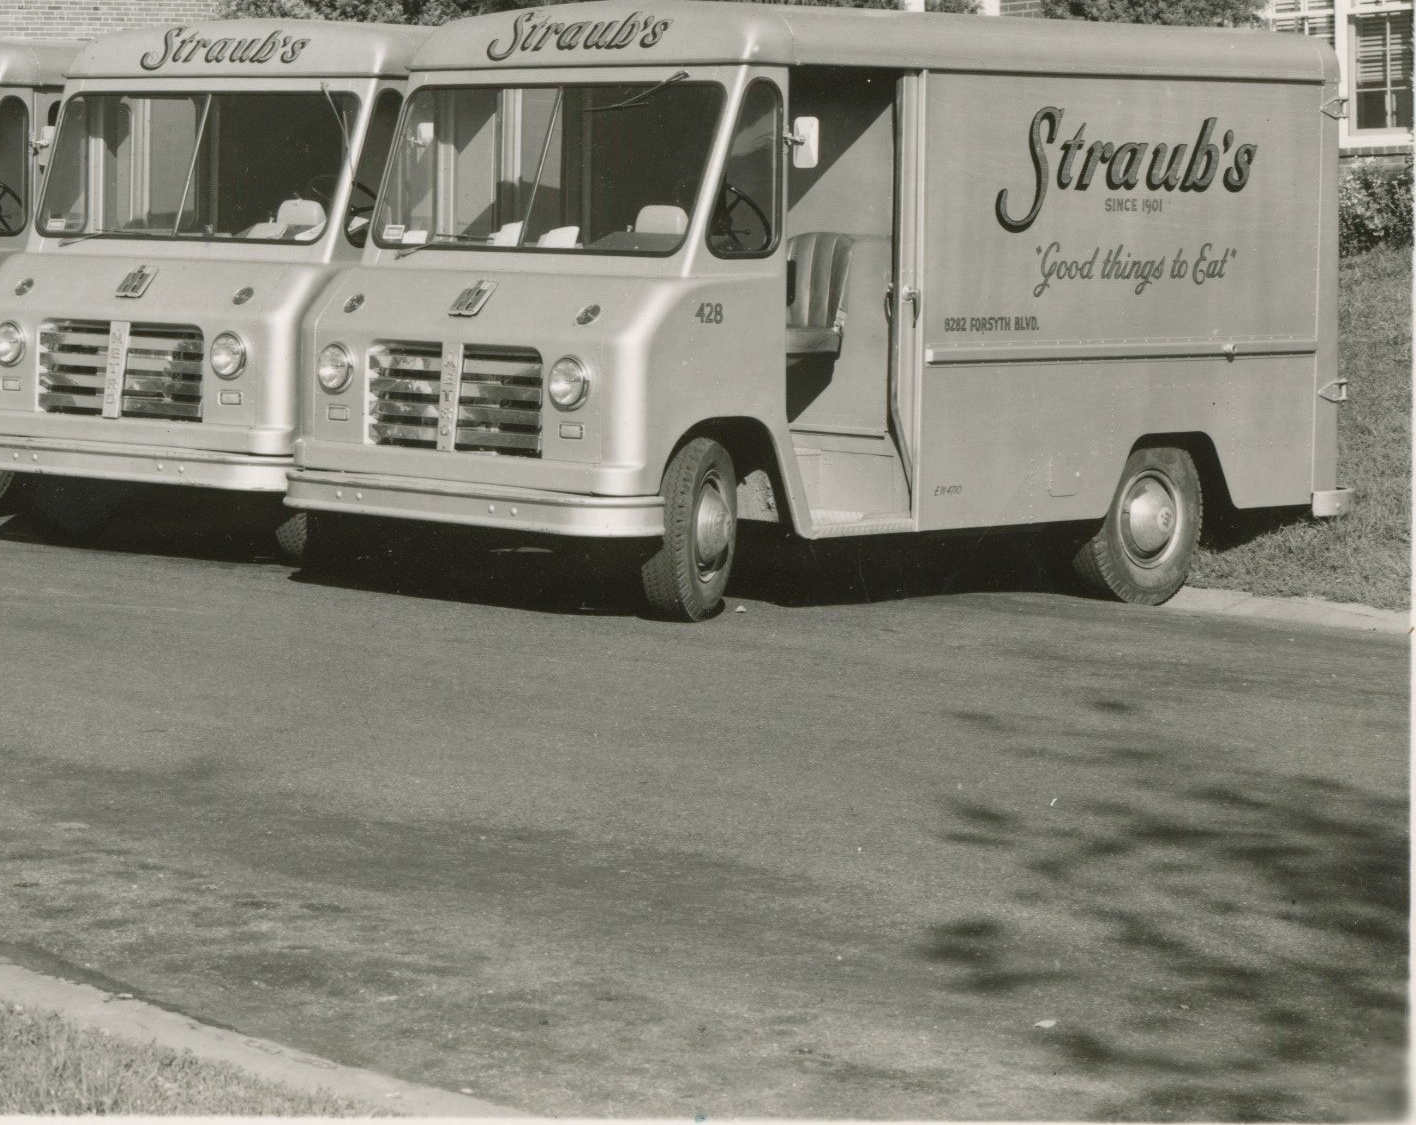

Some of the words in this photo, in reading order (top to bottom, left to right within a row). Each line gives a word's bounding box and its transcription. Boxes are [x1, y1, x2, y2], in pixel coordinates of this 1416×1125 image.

[140, 25, 312, 71] Straub's
[486, 11, 676, 61] Straub's
[995, 106, 1258, 233] Straub's
[1104, 198, 1137, 212] SINCE
[1141, 198, 1163, 214] 1901
[1033, 241, 1100, 297] "Good
[1101, 244, 1166, 295] things
[1170, 247, 1188, 280] to
[1192, 243, 1238, 285] Eat"
[694, 302, 724, 325] 428
[944, 317, 967, 332] 8282
[970, 317, 1011, 333] FORSYTH
[1014, 316, 1040, 331] BLVD.
